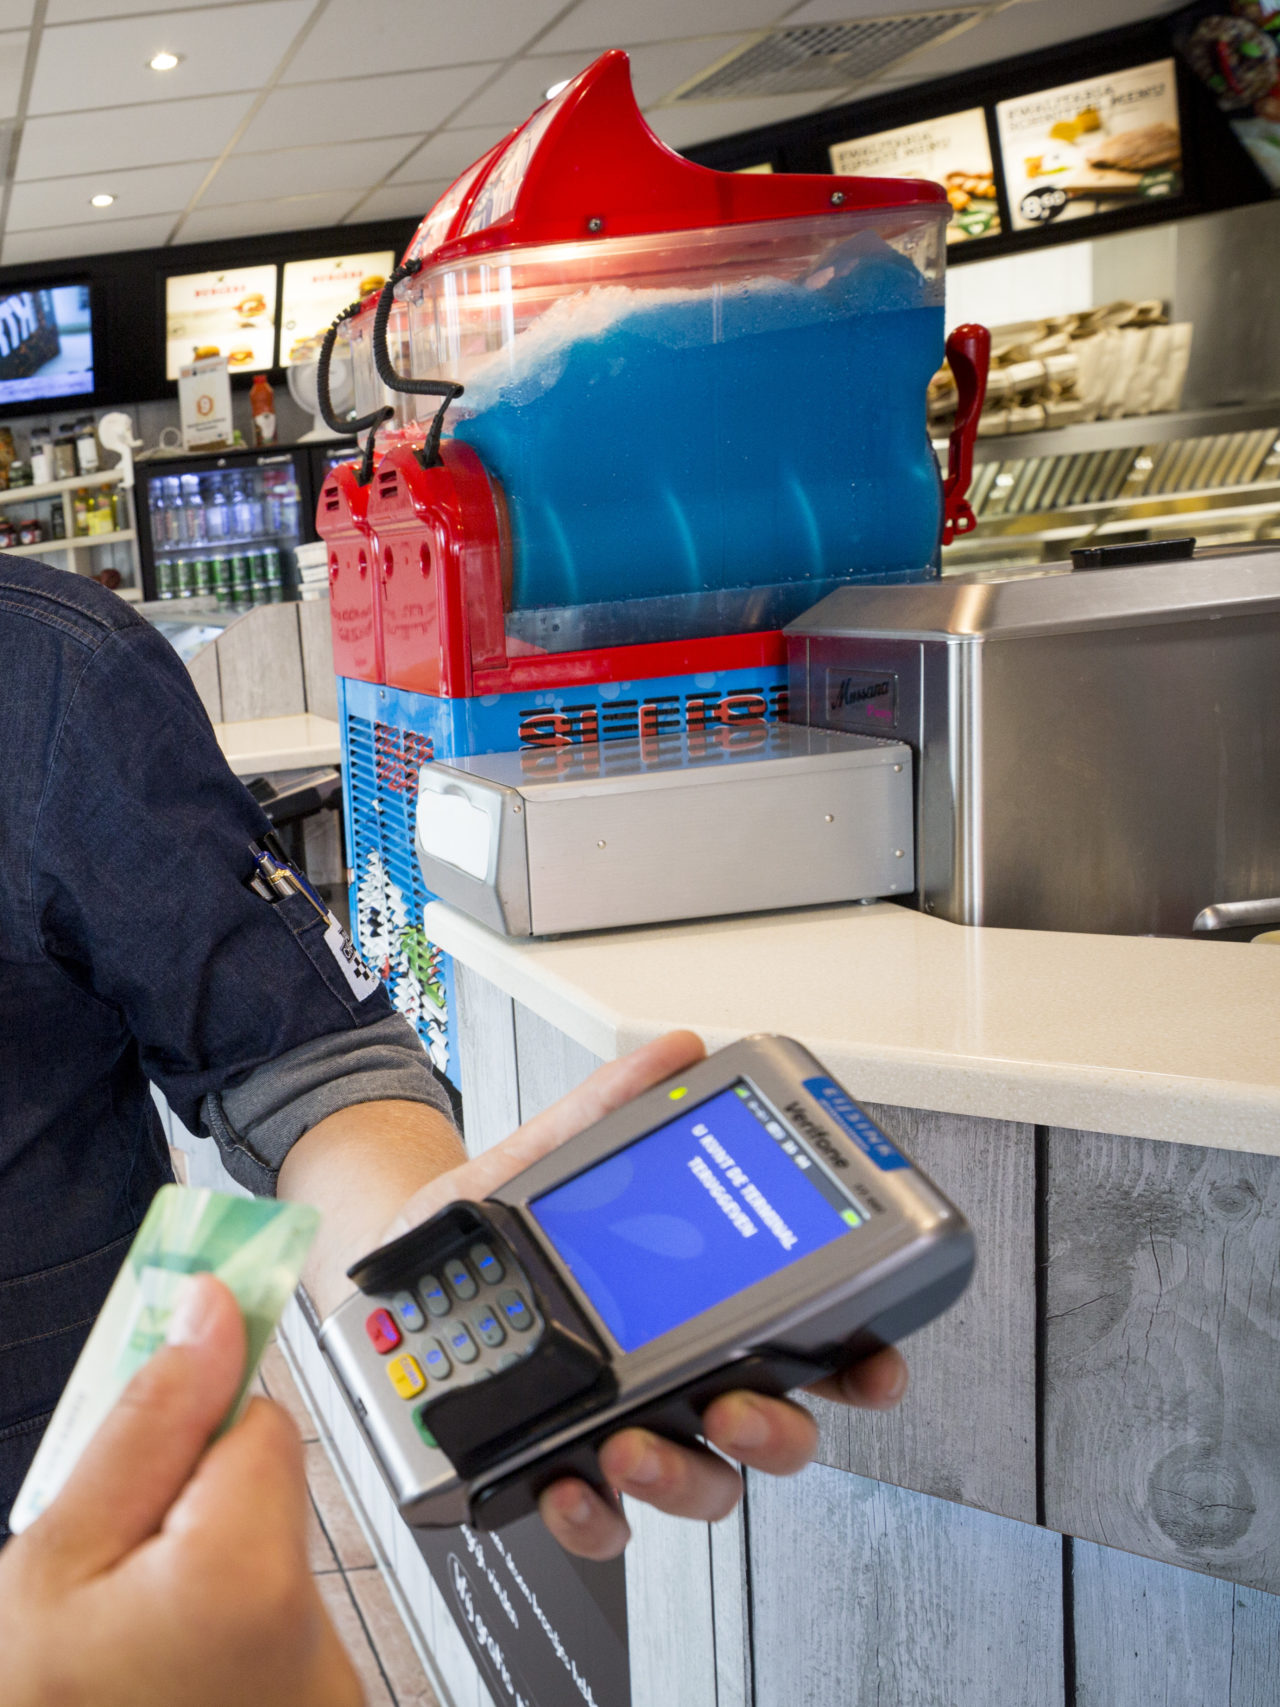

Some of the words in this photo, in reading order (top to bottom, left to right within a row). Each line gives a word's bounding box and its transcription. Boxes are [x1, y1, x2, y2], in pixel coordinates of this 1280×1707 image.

[691, 1123, 709, 1138] U
[698, 1133, 737, 1170] KUNT
[783, 1101, 850, 1169] Verifone
[687, 1155, 759, 1239] TERUGGEVEN
[724, 1166, 750, 1188] DE
[739, 1182, 799, 1251] TERMINAL
[453, 1273, 468, 1285] 4
[478, 1316, 497, 1332] 5
[479, 1255, 495, 1269] 1
[506, 1300, 525, 1317] 2
[426, 1287, 444, 1299] 7
[451, 1332, 469, 1348] 8
[425, 1349, 442, 1365] 0
